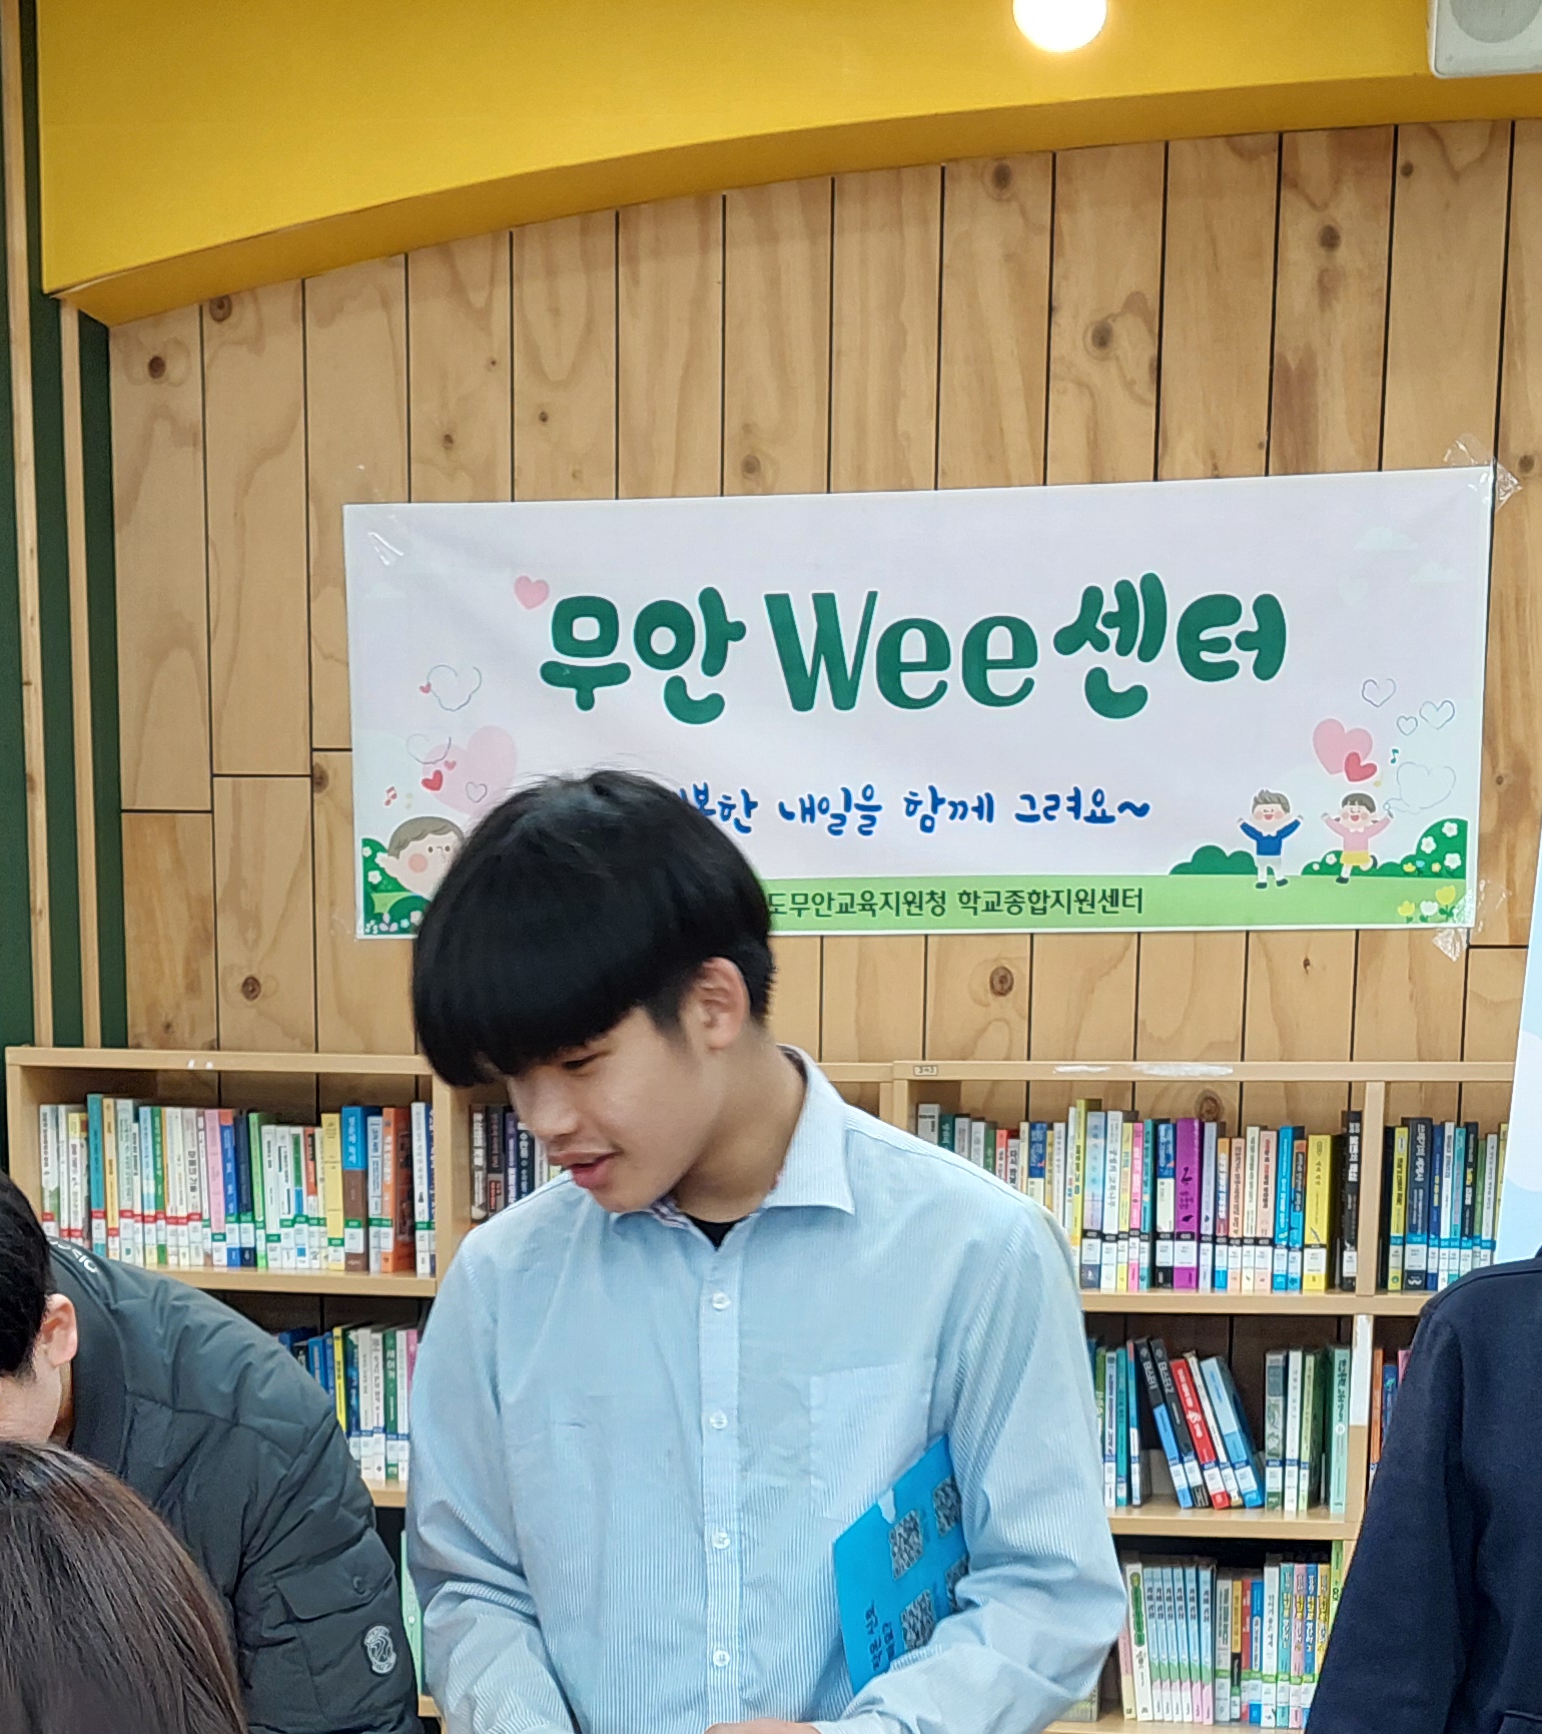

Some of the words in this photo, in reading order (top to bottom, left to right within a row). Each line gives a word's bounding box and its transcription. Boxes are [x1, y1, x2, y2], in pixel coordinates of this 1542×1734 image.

[539, 586, 746, 726] 무안
[762, 589, 1039, 712] Wee
[1053, 572, 1287, 719] 센터
[680, 782, 759, 833] 복한
[778, 785, 883, 836] 내일을
[904, 785, 995, 833] 함께
[1014, 786, 1151, 827] 그려요~
[767, 890, 947, 918] 도무안교육지원청
[958, 886, 1144, 915] 학교종합지원센터
